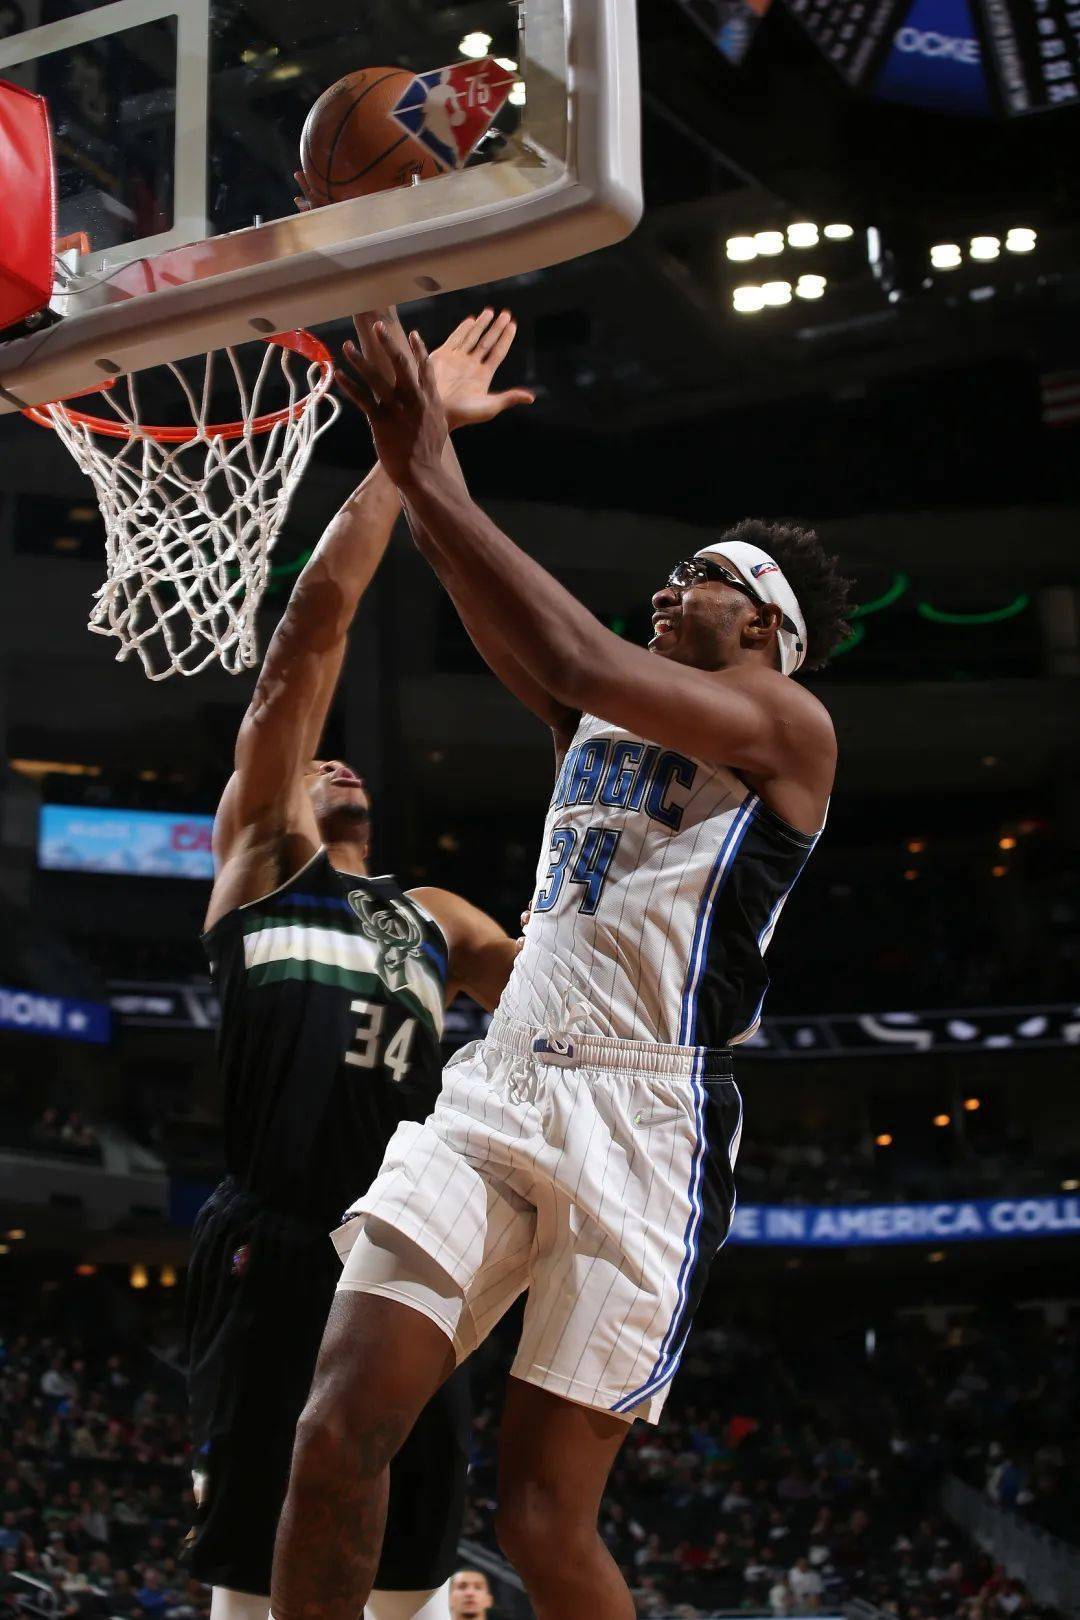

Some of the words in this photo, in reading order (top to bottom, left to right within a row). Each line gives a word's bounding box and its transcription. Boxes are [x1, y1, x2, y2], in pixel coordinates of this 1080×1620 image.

[465, 72, 490, 107] 75
[533, 827, 622, 916] 34
[344, 999, 418, 1083] 34
[765, 1208, 805, 1240] IN
[812, 1204, 984, 1240] AMERICA
